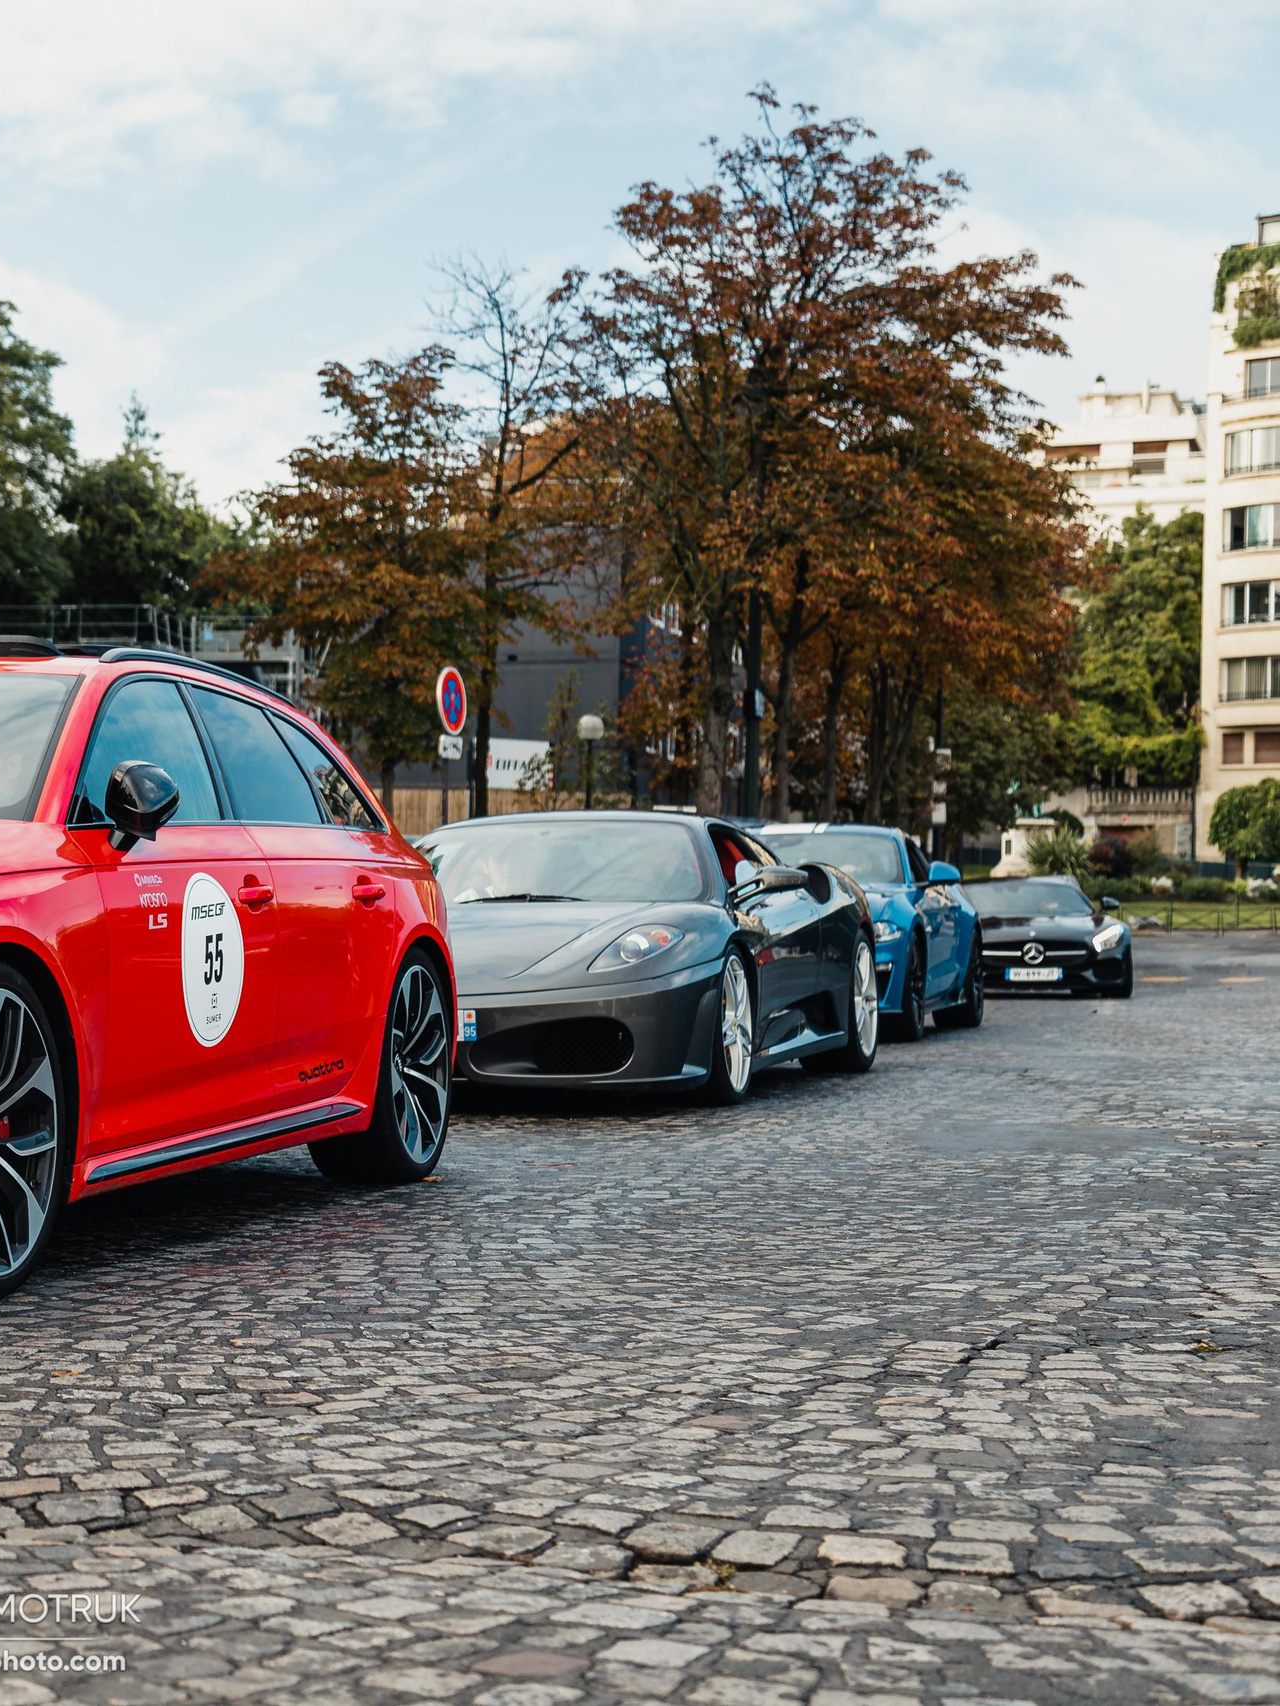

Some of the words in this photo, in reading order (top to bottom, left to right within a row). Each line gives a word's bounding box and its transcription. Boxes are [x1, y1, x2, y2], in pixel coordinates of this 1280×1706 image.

[148, 912, 168, 930] LS
[204, 933, 223, 985] 55
[464, 1026, 477, 1037] 95
[299, 1059, 344, 1084] quattro
